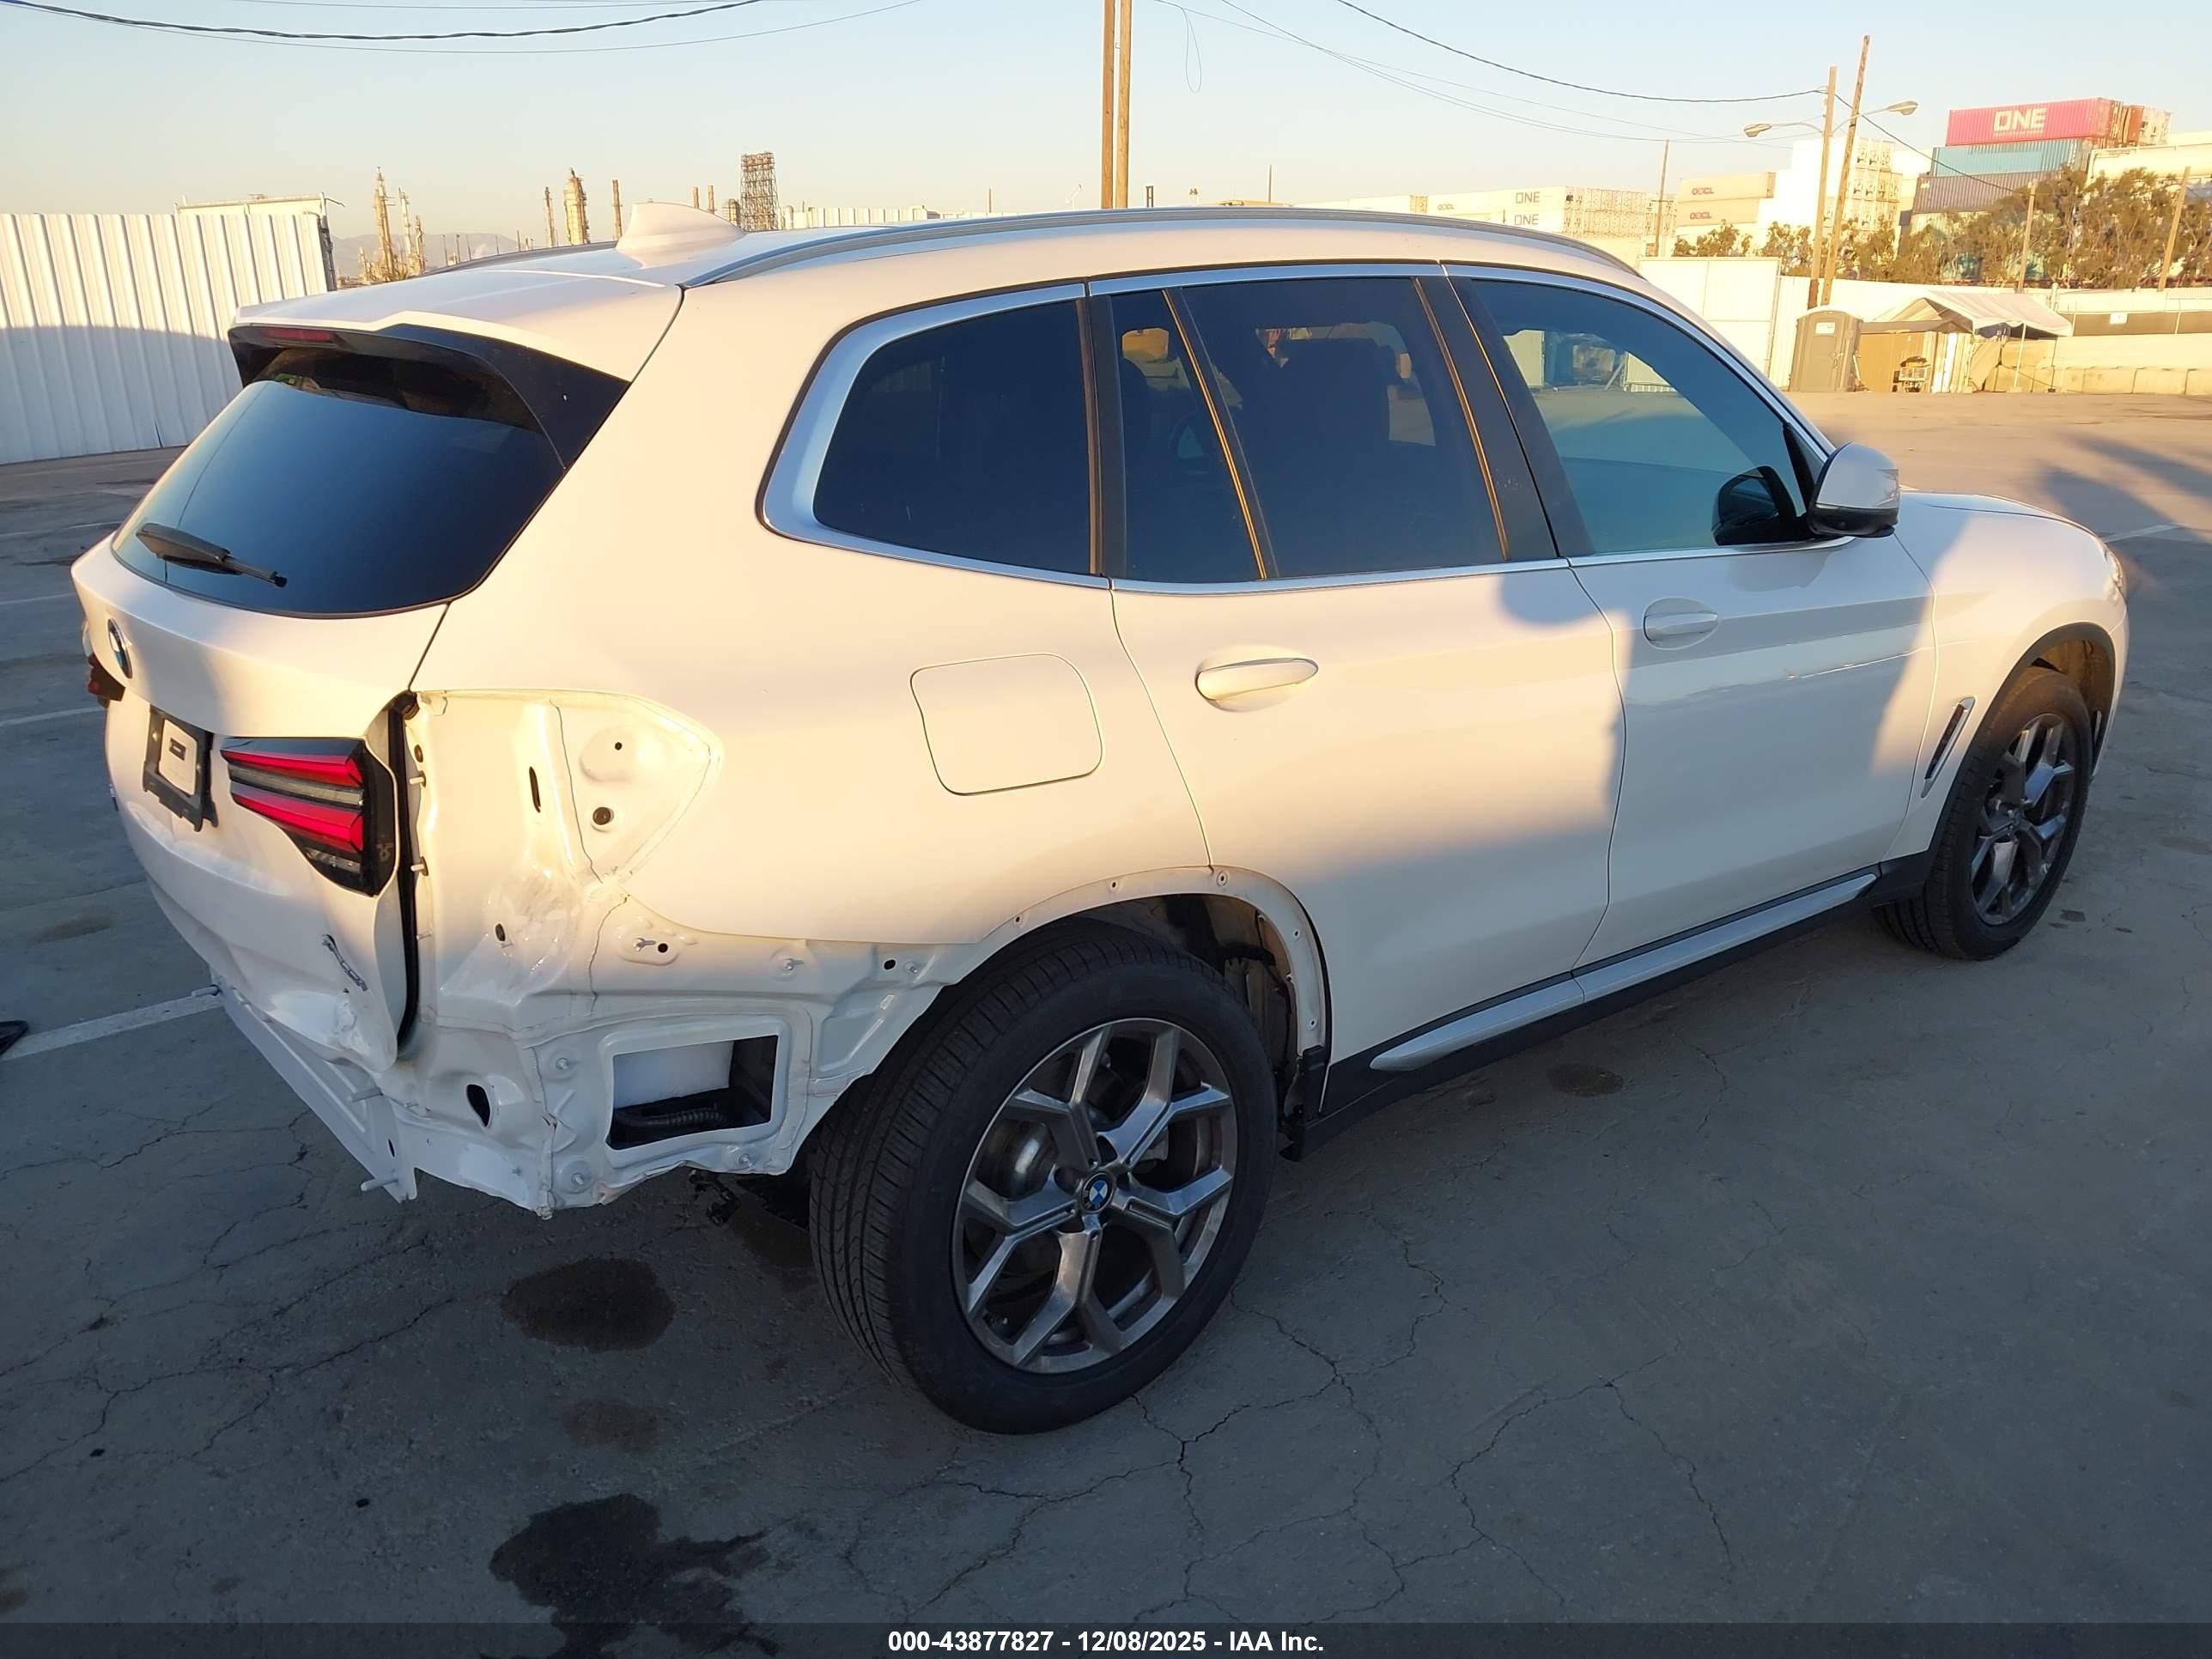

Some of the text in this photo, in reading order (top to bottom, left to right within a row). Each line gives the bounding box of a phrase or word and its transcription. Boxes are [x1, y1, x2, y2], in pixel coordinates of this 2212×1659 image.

[1993, 107, 2047, 131] ONE
[1516, 191, 1541, 204] ONE
[1514, 213, 1540, 226] ONE
